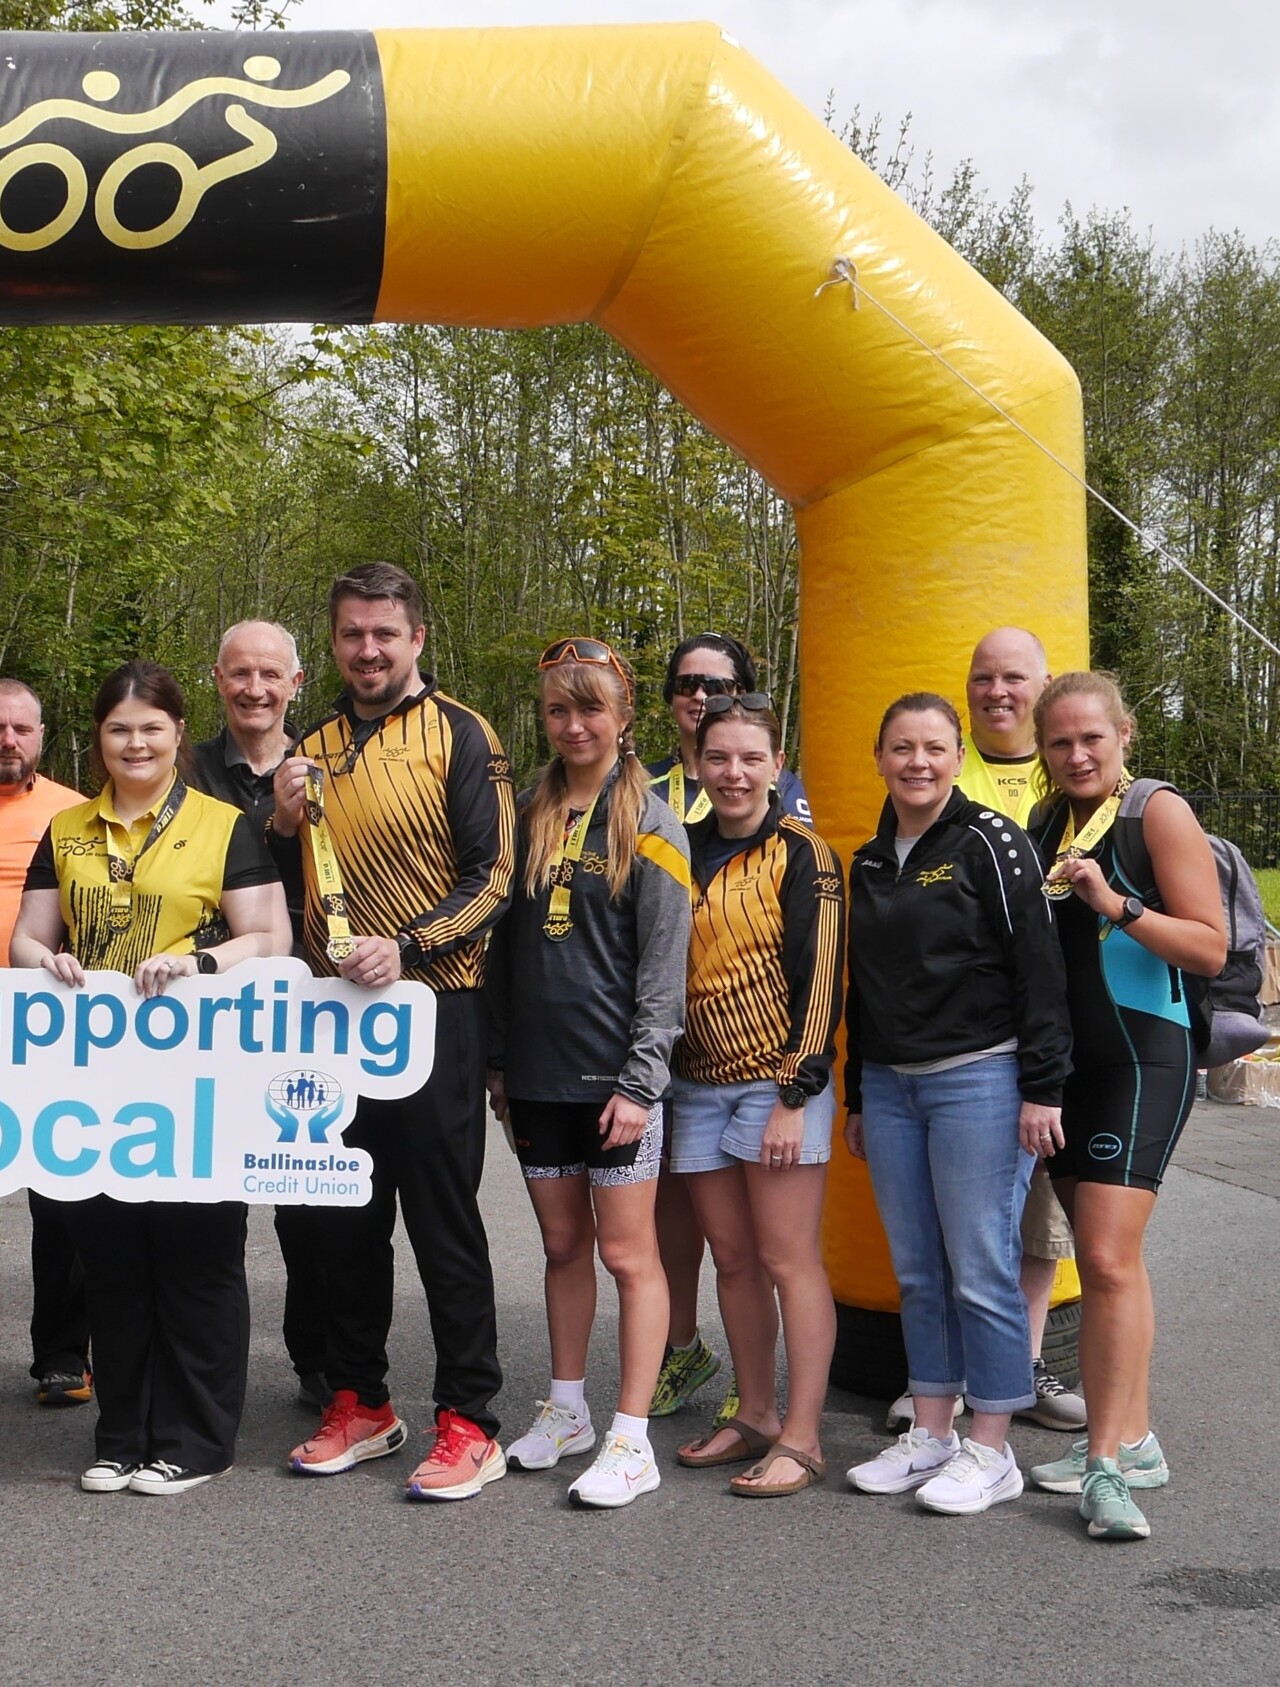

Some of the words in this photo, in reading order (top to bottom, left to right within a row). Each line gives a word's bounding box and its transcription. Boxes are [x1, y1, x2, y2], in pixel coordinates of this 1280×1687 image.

[997, 777, 1027, 786] KCS
[243, 1153, 360, 1172] Ballinasloe
[243, 1175, 299, 1194] Credit
[305, 1176, 359, 1195] Union
